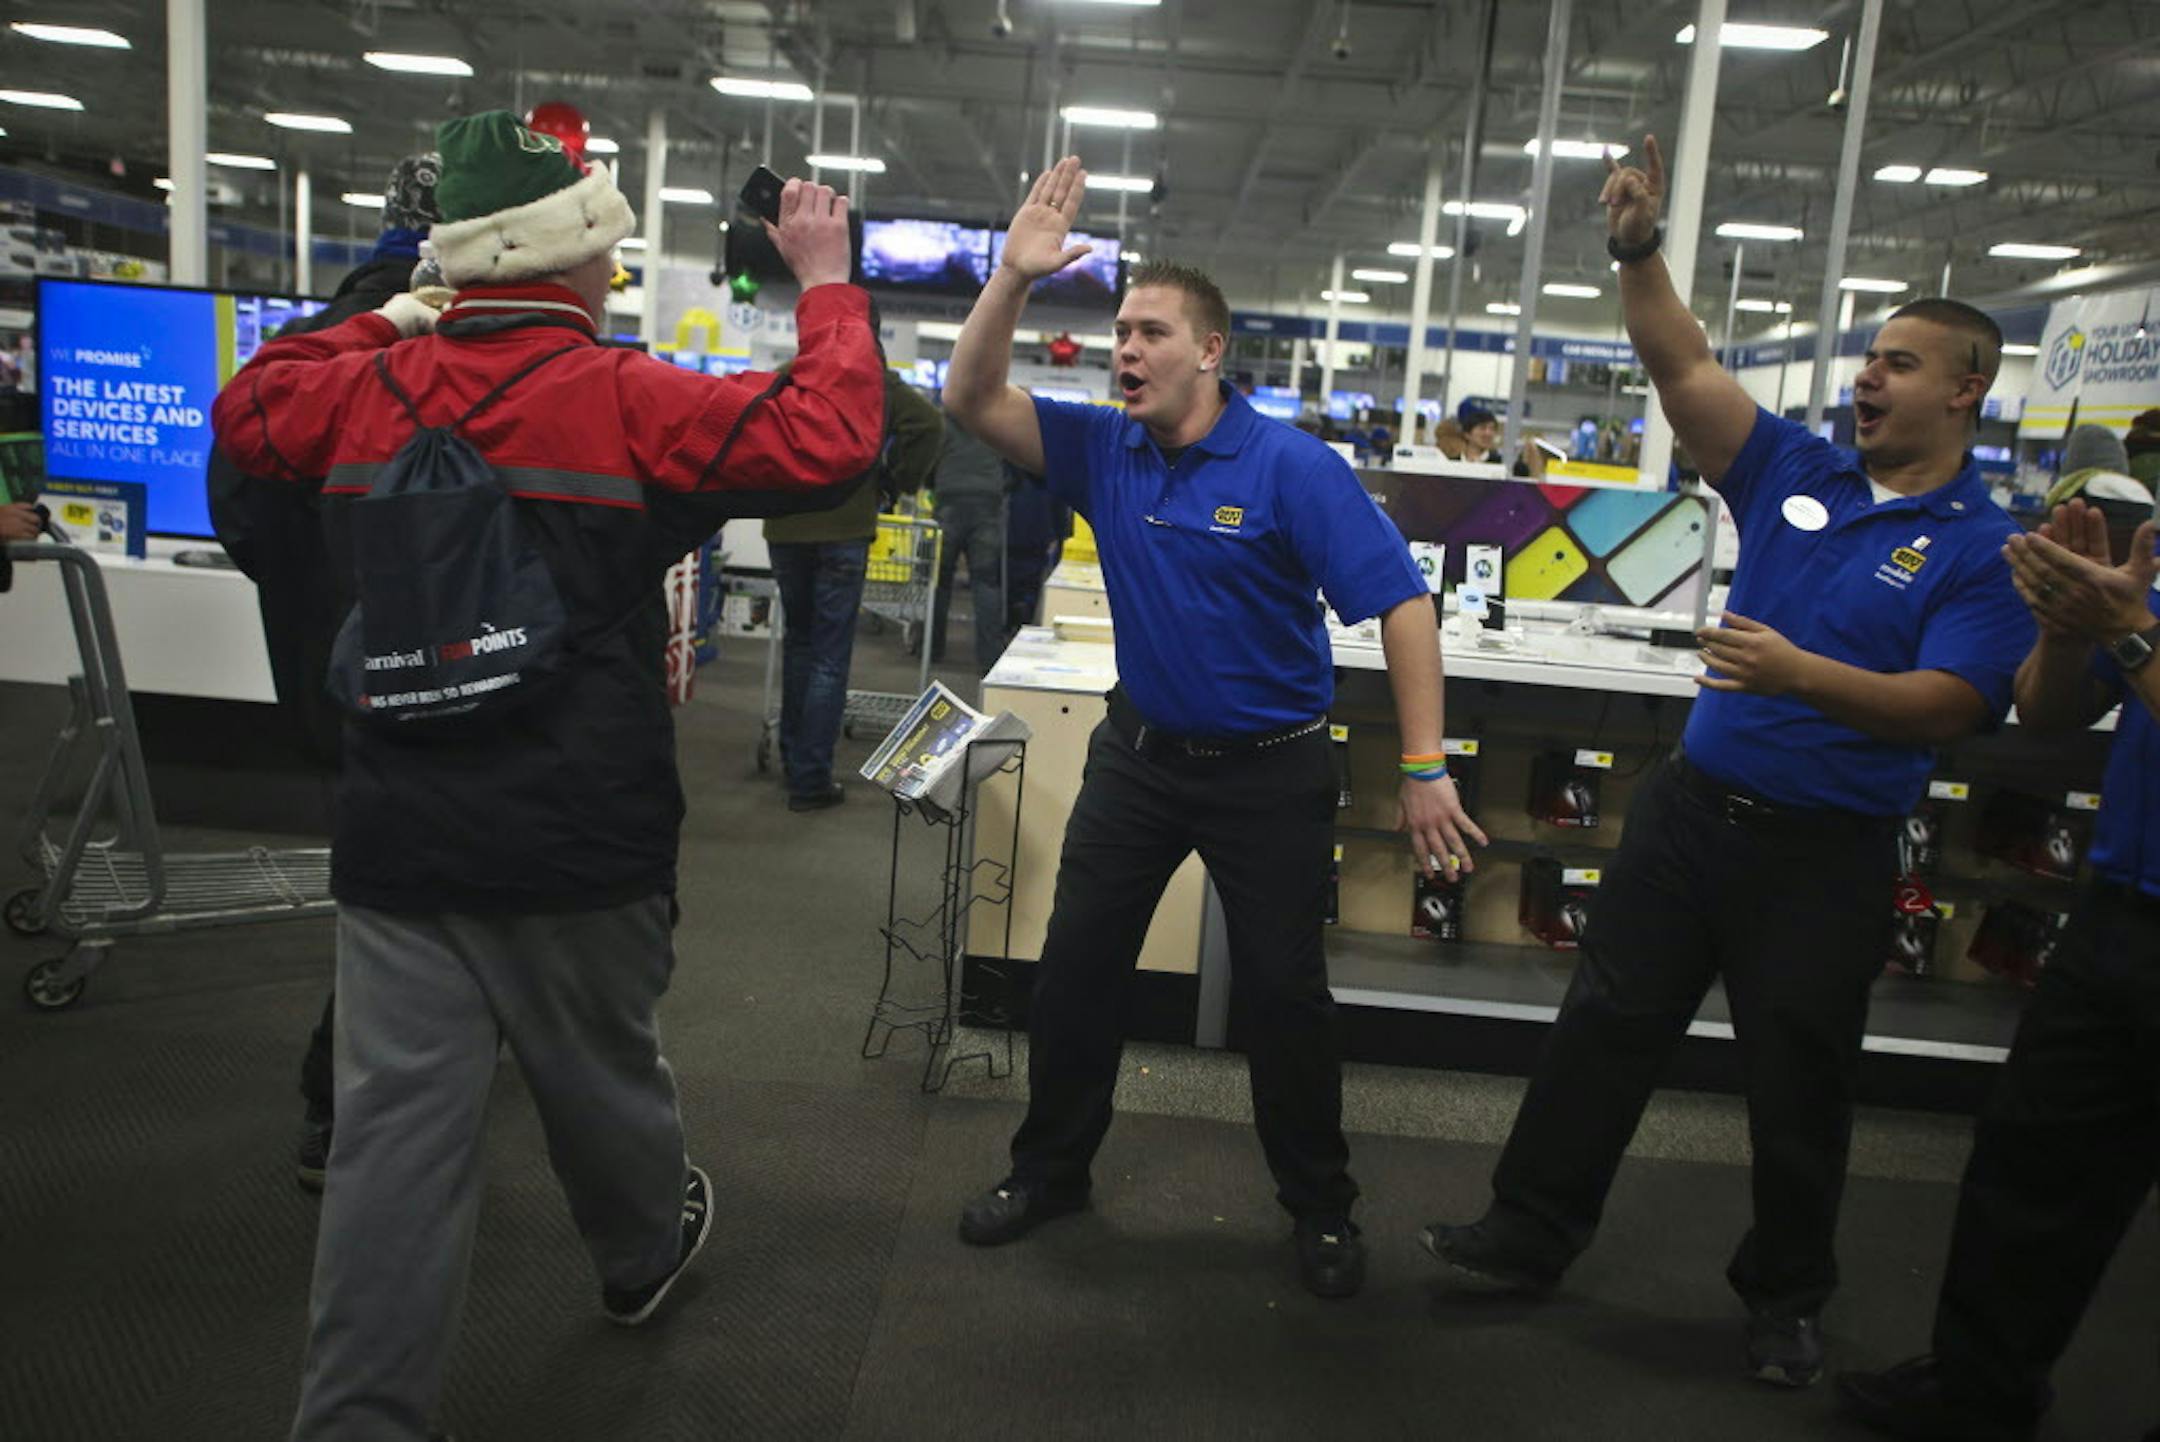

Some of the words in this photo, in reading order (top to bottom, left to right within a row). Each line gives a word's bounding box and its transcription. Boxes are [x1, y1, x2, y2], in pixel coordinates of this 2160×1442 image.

[51, 348, 71, 363] WE
[75, 349, 142, 368] PROMISE
[52, 376, 96, 397] THE
[104, 381, 185, 404] LATEST
[53, 398, 146, 422] DEVICES
[152, 406, 204, 428] AND
[53, 419, 158, 445] SERVICES
[52, 441, 83, 458] ALL
[86, 445, 105, 460] IN
[108, 446, 147, 464] ONE
[151, 448, 202, 469] PLACE
[364, 649, 426, 671] arnival
[1902, 887, 1925, 909] 2
